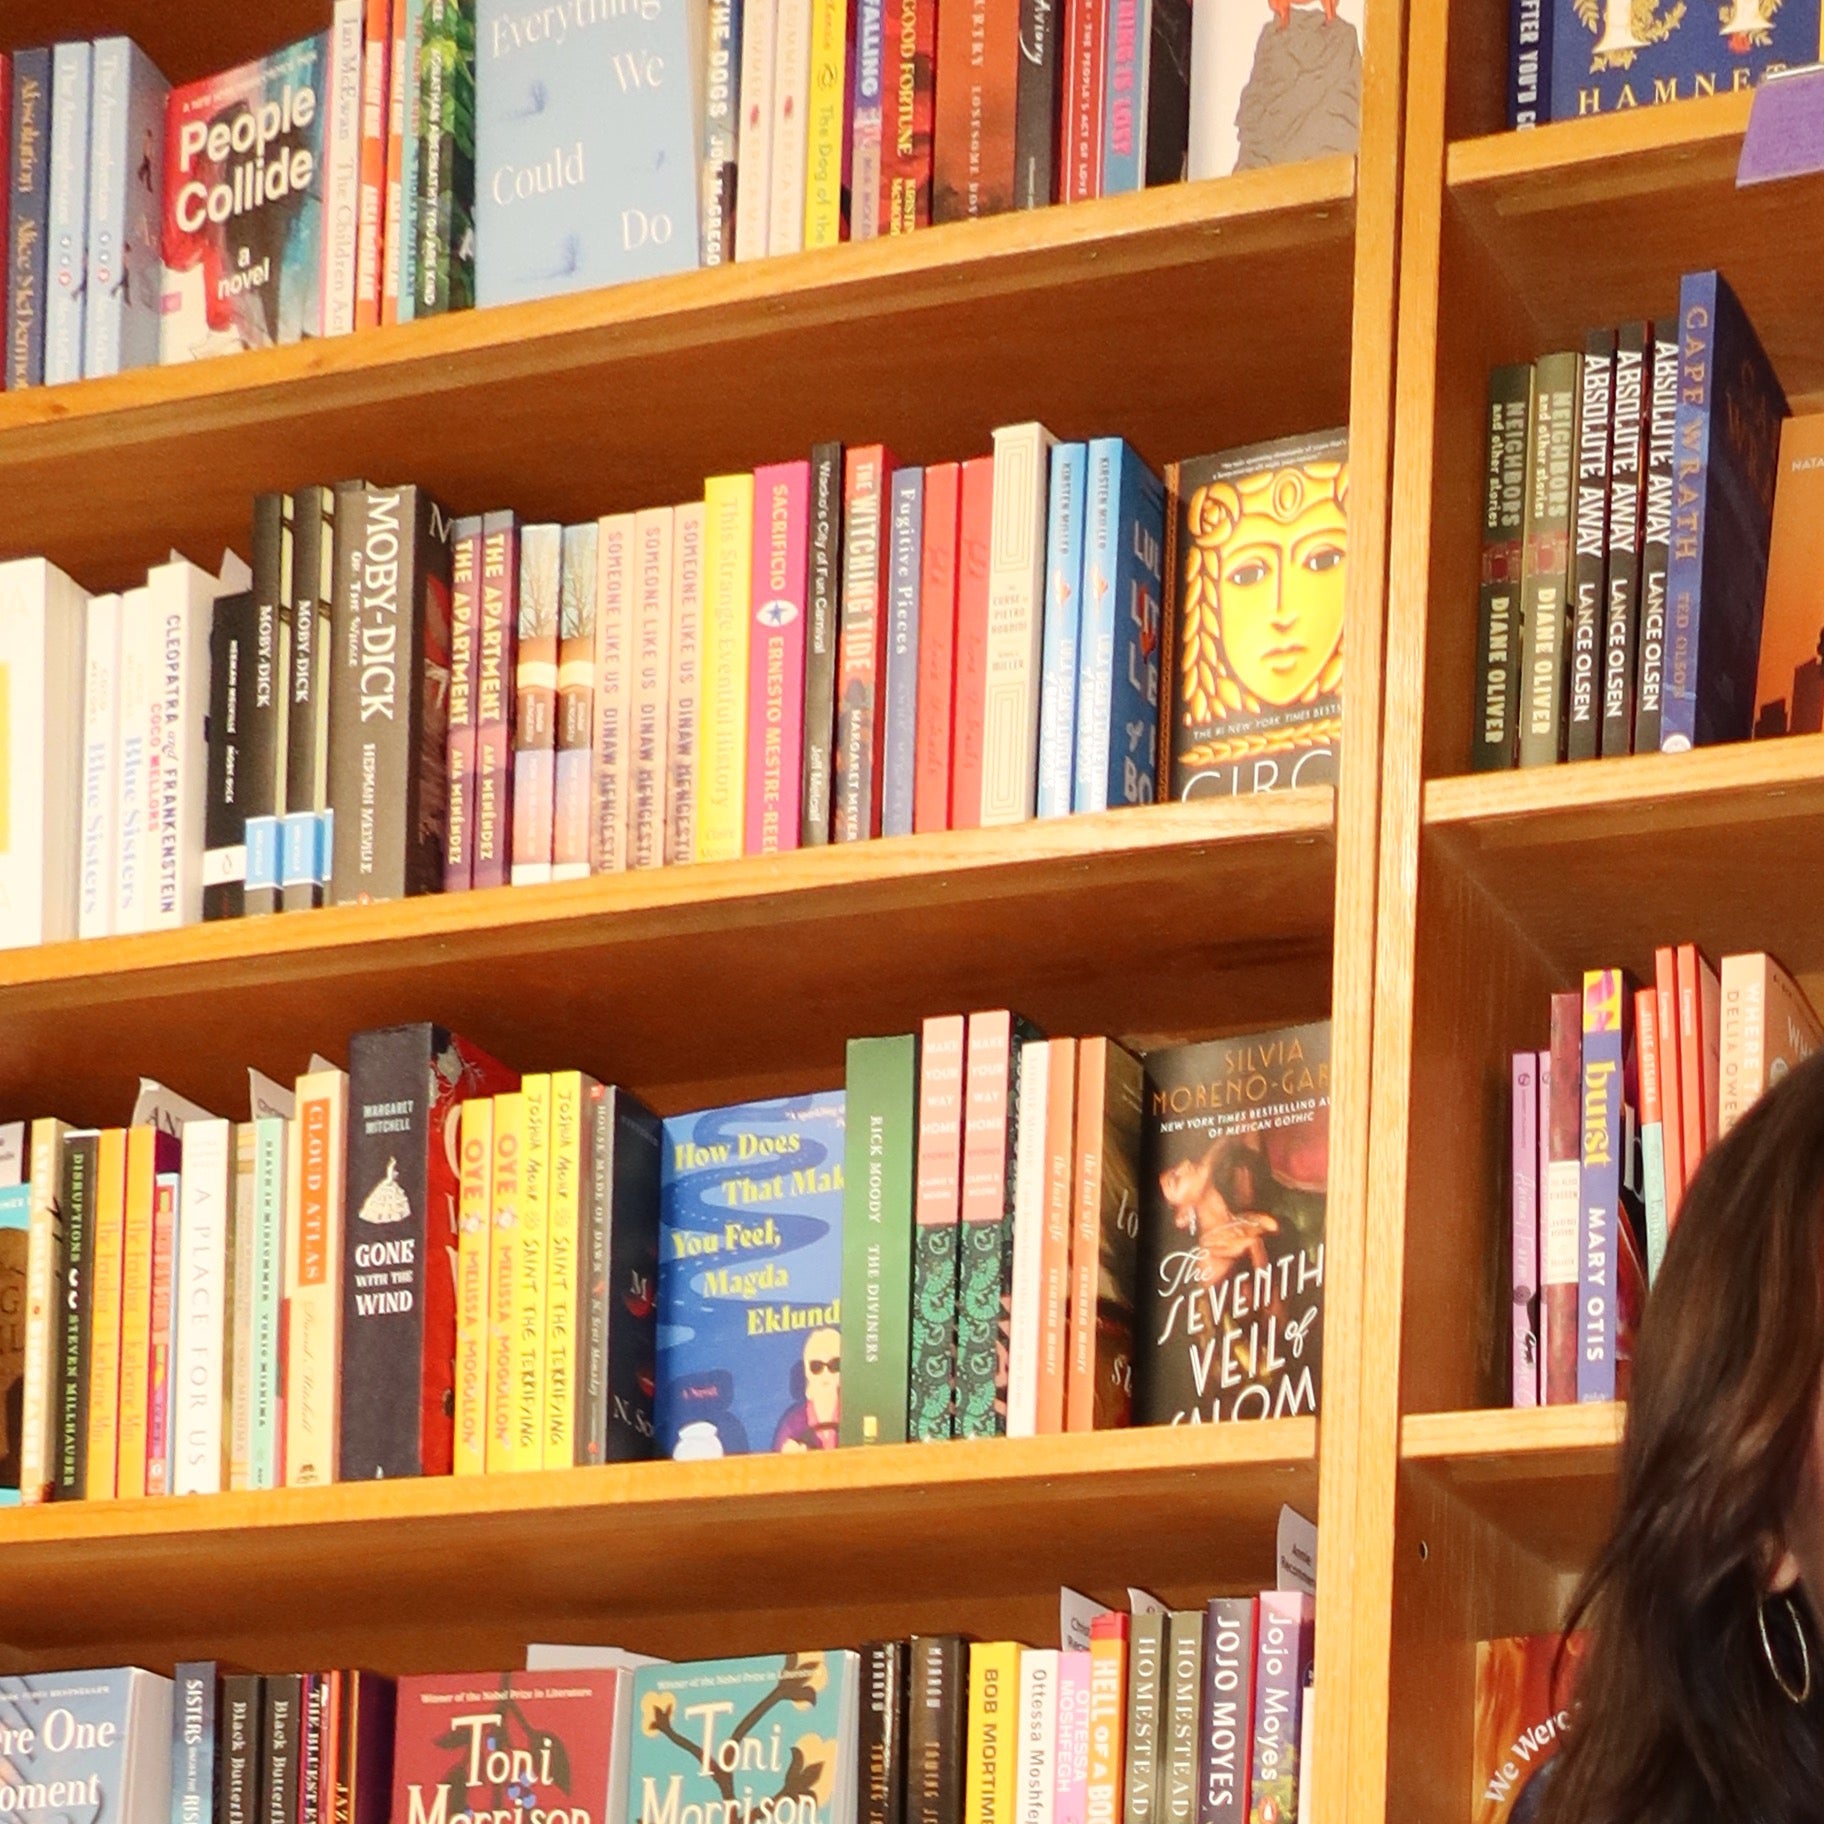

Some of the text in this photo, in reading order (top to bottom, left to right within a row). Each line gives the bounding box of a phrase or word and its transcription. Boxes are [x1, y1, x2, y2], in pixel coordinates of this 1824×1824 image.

[611, 49, 665, 95] We
[1578, 63, 1788, 116] HAMNE
[178, 82, 317, 172] People
[175, 147, 315, 234] Collide
[492, 142, 585, 208] Could
[237, 247, 250, 264] a
[621, 211, 672, 253] Do
[217, 258, 270, 301] novel
[1576, 354, 1610, 557] ABSOLUTE AWAY
[845, 462, 876, 673] THE WITCHING TIDE
[361, 494, 400, 722] MOBY-DICK
[480, 533, 504, 722] THE APARTMENT
[767, 484, 788, 722] SACRIFICIO ERNESTO
[160, 615, 182, 912] CLEOPATRA FRANKENSTEIN
[1225, 1038, 1306, 1074] SILVIA
[363, 1100, 414, 1118] MARGARET
[365, 1116, 410, 1134] MITCHELL
[674, 1131, 800, 1170] How Does
[304, 1105, 325, 1281] CLOUD ATLAS
[723, 1172, 785, 1206] That
[1583, 1060, 1616, 1361] burst MARY OTIS
[354, 1239, 416, 1268] GONE
[672, 1222, 782, 1260] You Feel,
[355, 1270, 413, 1286] WITH THE
[703, 1263, 789, 1298] Magda
[1158, 1243, 1325, 1347] SEVENTH
[1159, 1249, 1214, 1295] The
[355, 1291, 413, 1316] WIND
[747, 1299, 839, 1335] Eklund
[1189, 1307, 1316, 1397] VEIL of
[982, 1669, 998, 1712] BOB
[1209, 1615, 1241, 1807] JOJO MOYES
[453, 1714, 553, 1787] Toni
[685, 1703, 782, 1777] Toni
